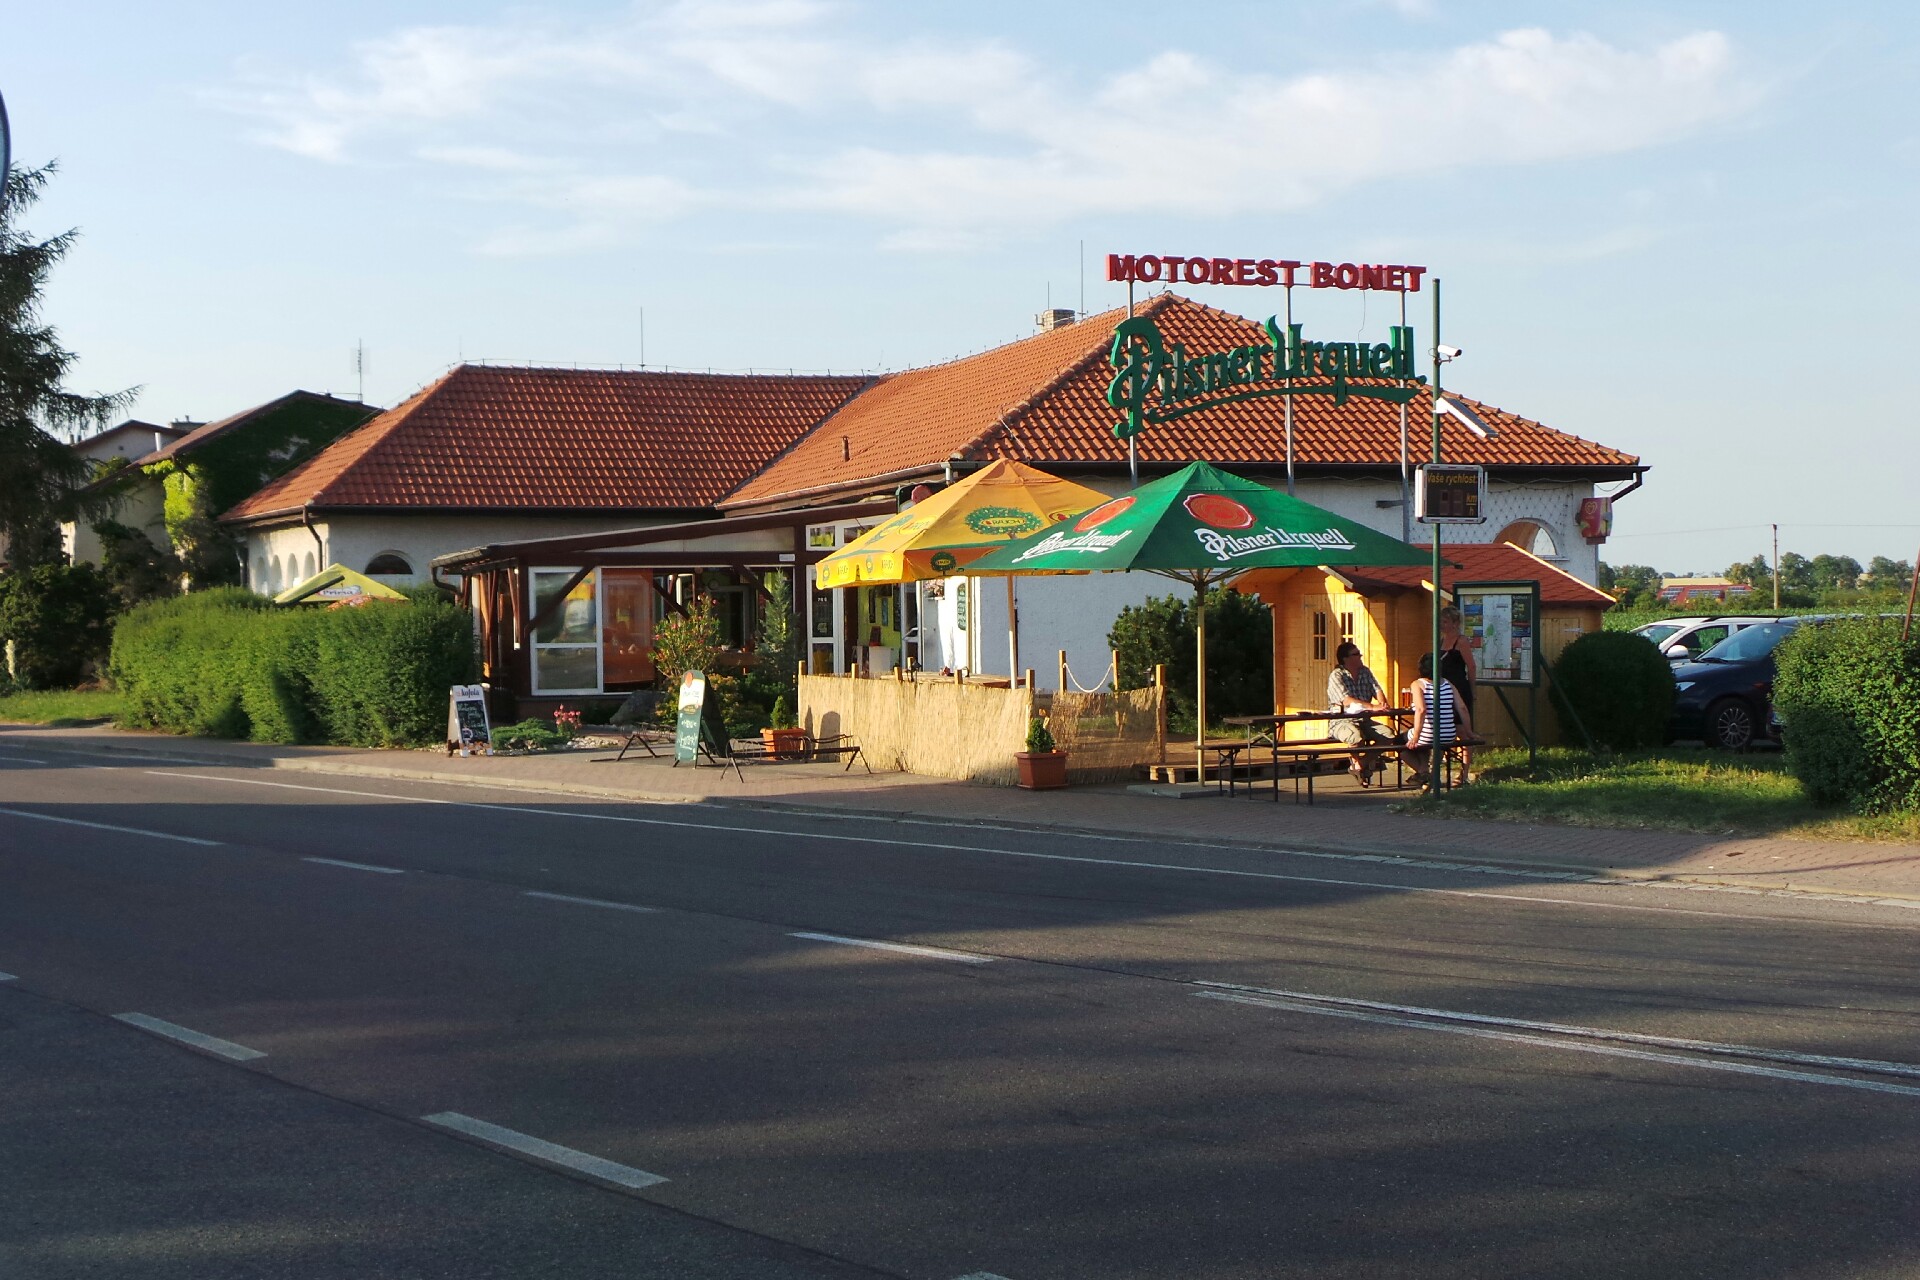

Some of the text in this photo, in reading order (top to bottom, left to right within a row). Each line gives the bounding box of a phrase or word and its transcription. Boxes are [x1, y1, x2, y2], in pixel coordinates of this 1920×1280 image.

[1106, 254, 1427, 292] MOTOREST BONET
[1107, 314, 1427, 439] Pilsner Urquell
[1466, 494, 1477, 503] km
[1073, 529, 1133, 553] Urquell
[1193, 526, 1350, 561] Pilsner Urquell
